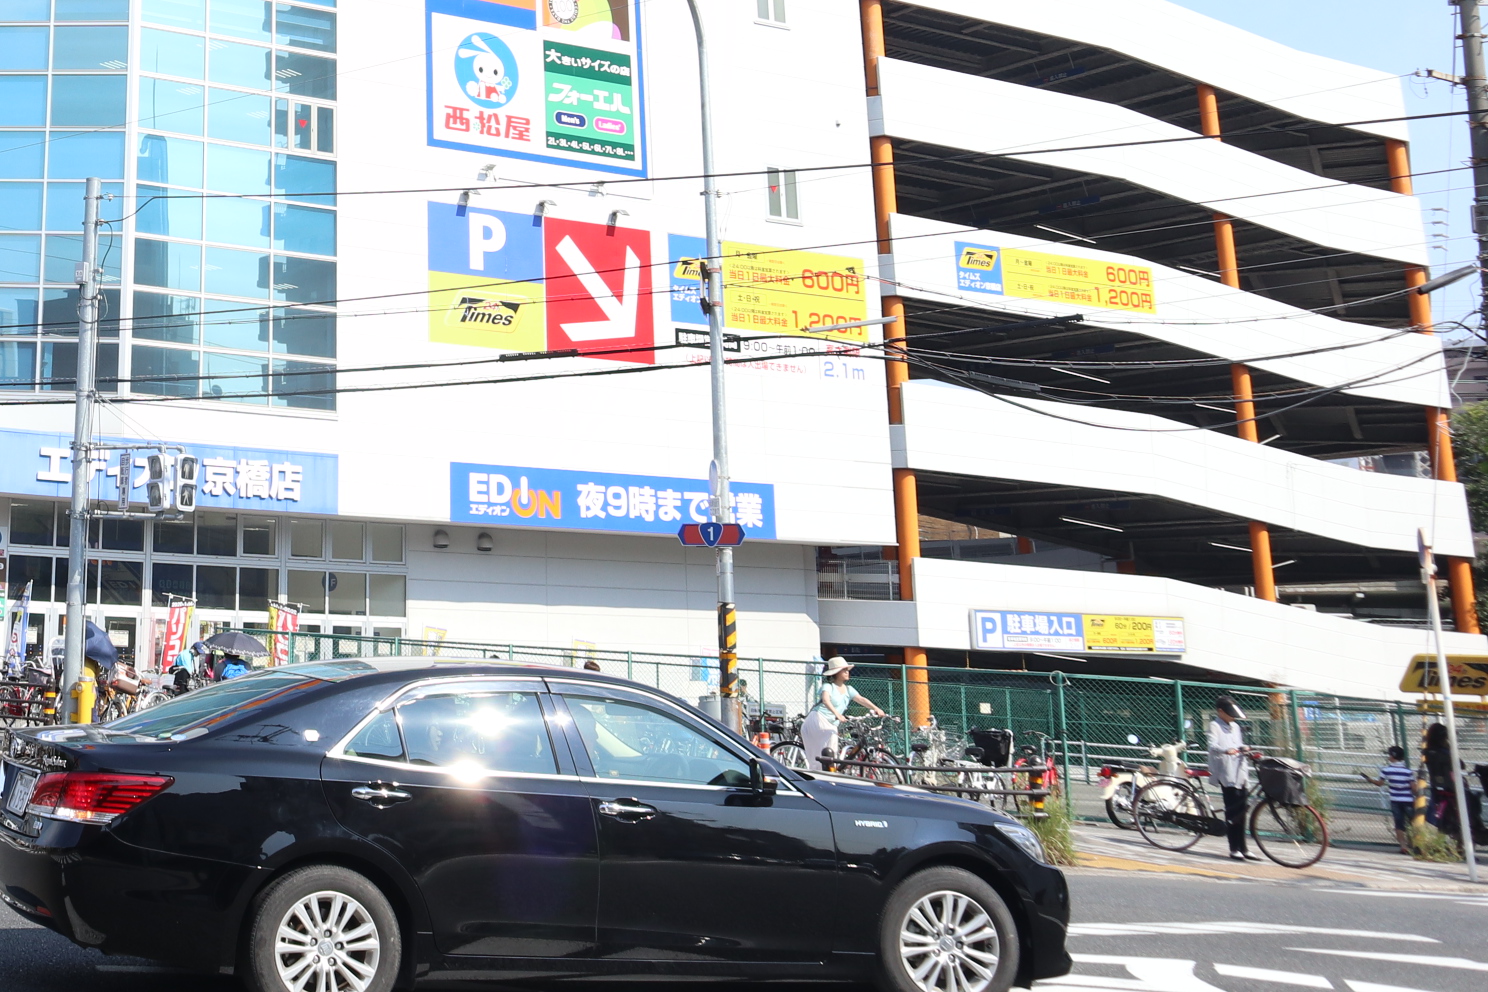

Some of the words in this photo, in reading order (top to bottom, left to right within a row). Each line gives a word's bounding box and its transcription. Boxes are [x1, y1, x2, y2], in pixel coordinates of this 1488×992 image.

[545, 48, 631, 77] 大きいサイズの店
[547, 82, 631, 115] フォーエル
[443, 104, 531, 142] 西松屋
[468, 212, 507, 271] P
[965, 251, 992, 267] Times
[801, 268, 860, 295] 600円
[1105, 265, 1150, 288] 600円
[458, 297, 515, 326] Times
[791, 310, 863, 336] 1200円
[823, 361, 865, 381] 2.1m
[36, 446, 303, 502] エディ京橋店
[468, 472, 561, 520] EDION
[469, 504, 510, 517] エディオン
[707, 526, 715, 541] 1
[981, 616, 997, 643] P
[1006, 614, 1076, 635] 駐車場入口
